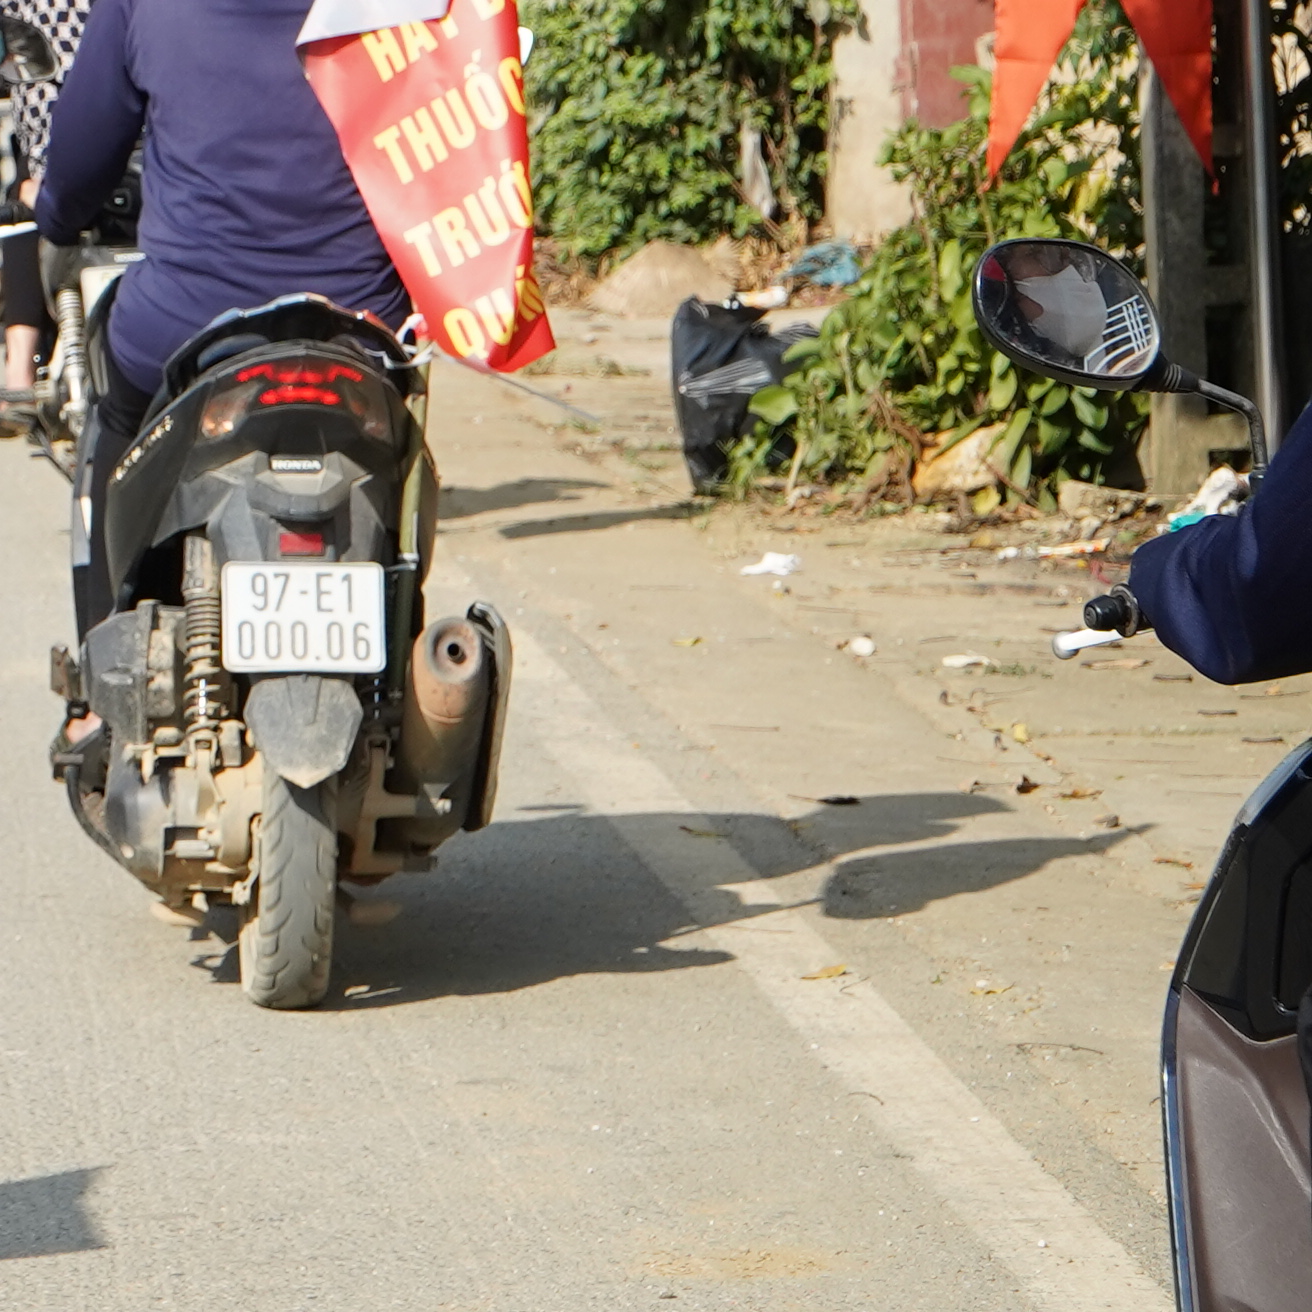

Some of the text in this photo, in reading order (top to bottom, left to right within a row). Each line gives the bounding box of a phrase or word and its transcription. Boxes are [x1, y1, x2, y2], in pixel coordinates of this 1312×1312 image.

[373, 49, 526, 185] THUỐC
[403, 157, 534, 278] TRƯỚ
[250, 572, 354, 613] 97-E1
[237, 620, 372, 661] 000.06
